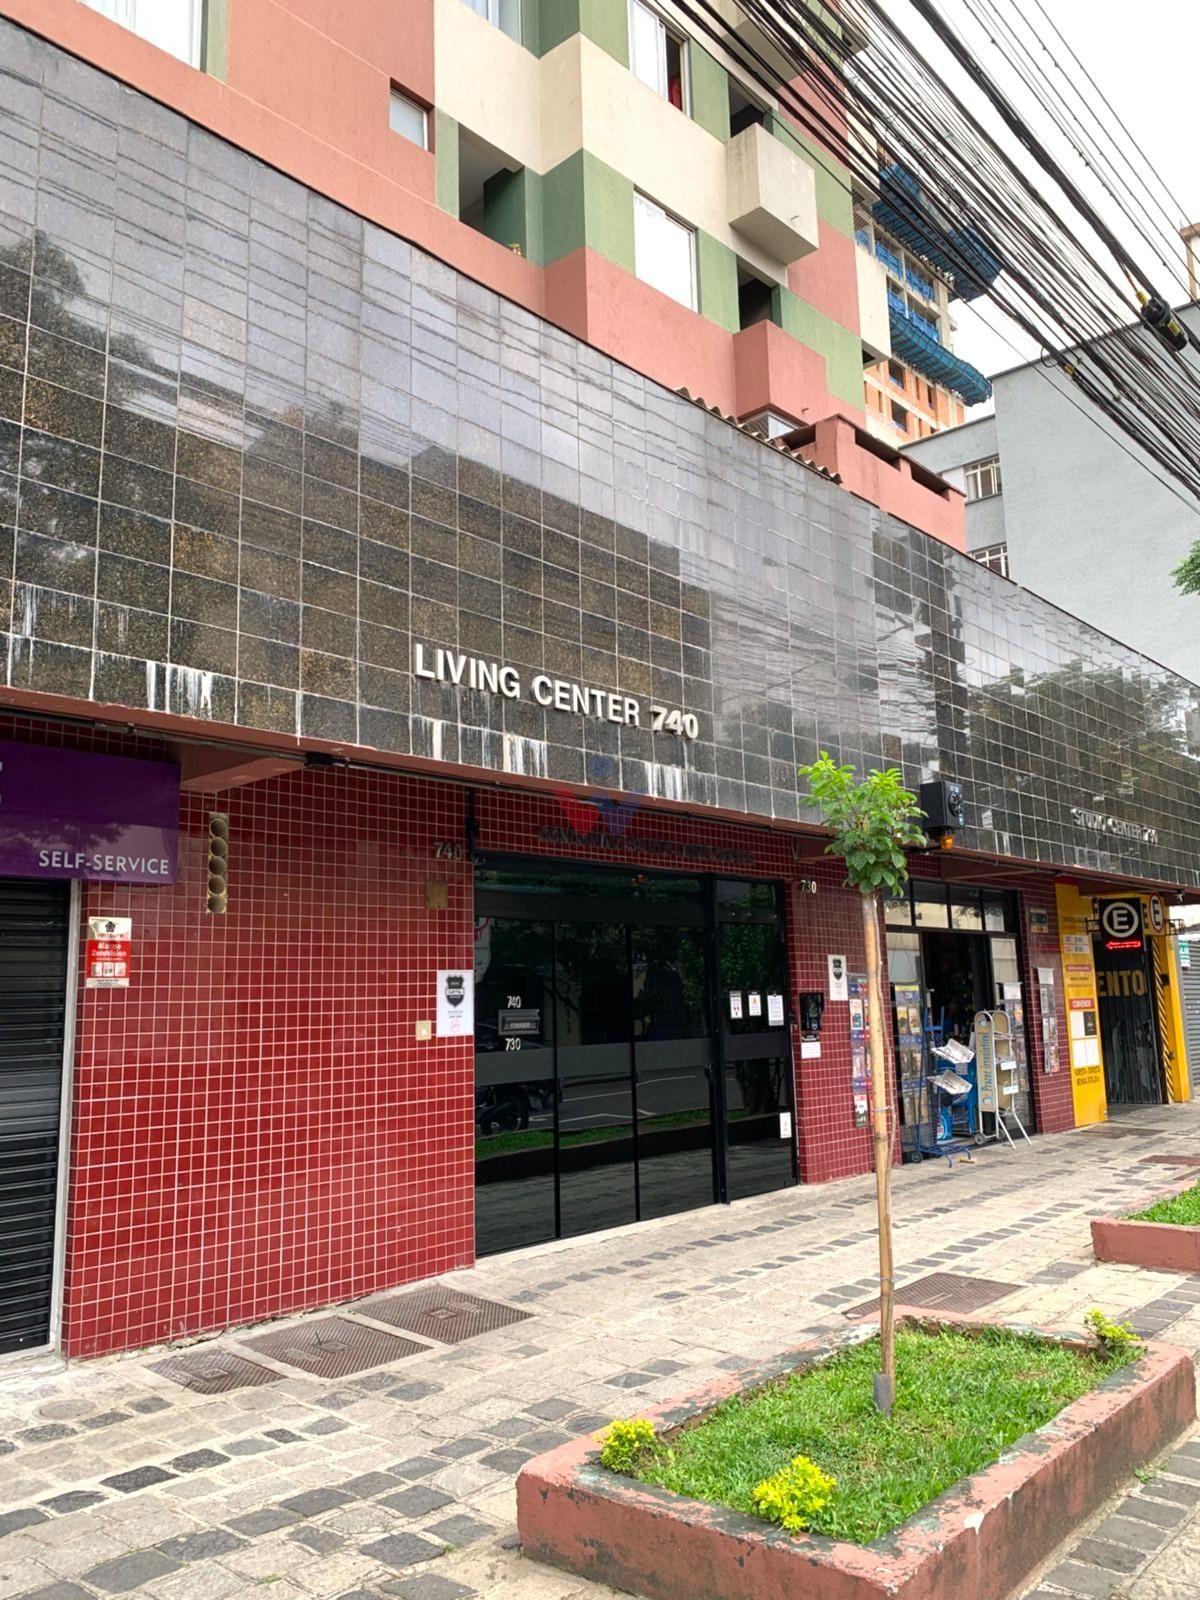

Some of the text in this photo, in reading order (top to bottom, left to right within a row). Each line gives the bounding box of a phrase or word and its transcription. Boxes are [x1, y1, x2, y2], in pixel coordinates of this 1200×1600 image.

[415, 643, 699, 739] LIVING CENTER 740
[432, 842, 462, 860] 740
[38, 848, 170, 875] SELF-SERVICE
[1112, 909, 1129, 930] E
[507, 996, 522, 1009] 740
[505, 1038, 521, 1052] 730
